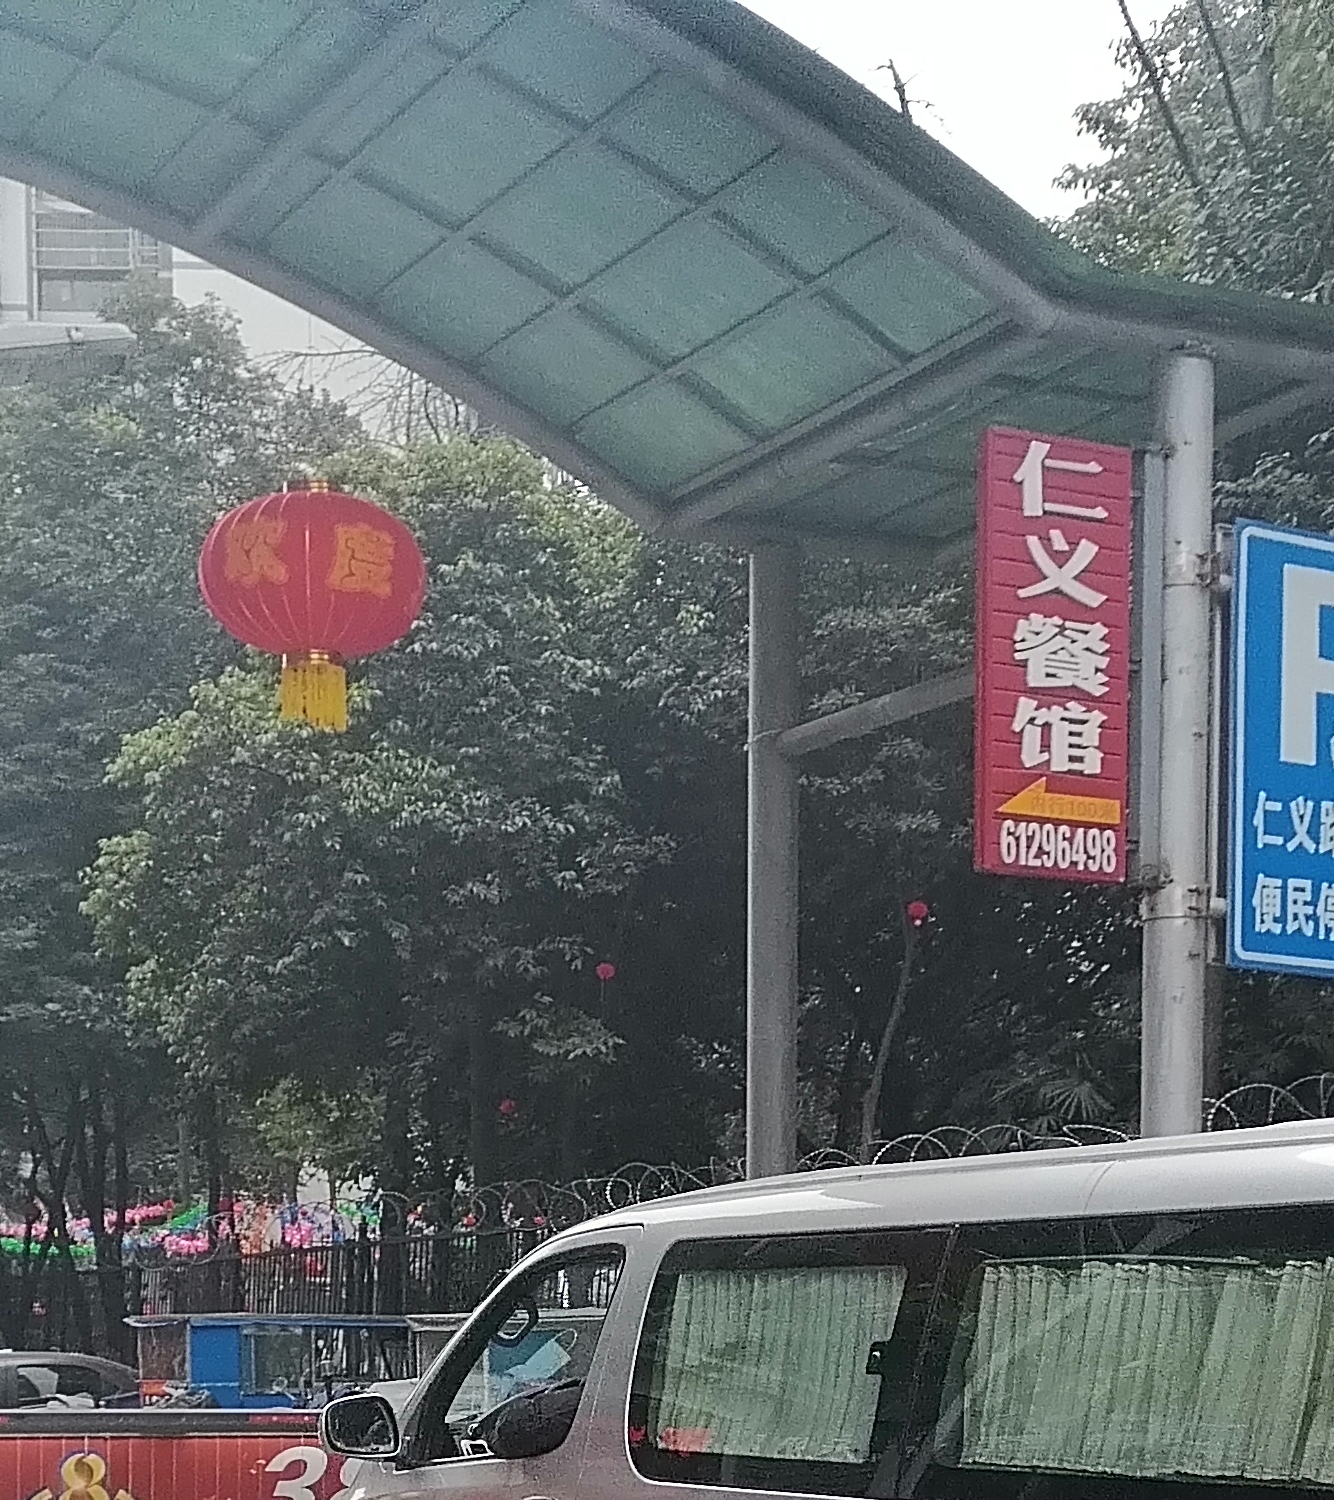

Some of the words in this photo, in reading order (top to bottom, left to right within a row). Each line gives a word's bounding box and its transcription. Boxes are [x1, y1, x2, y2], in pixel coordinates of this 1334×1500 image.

[1012, 439, 1111, 775] 仁义餐馆
[999, 820, 1117, 874] 61296498
